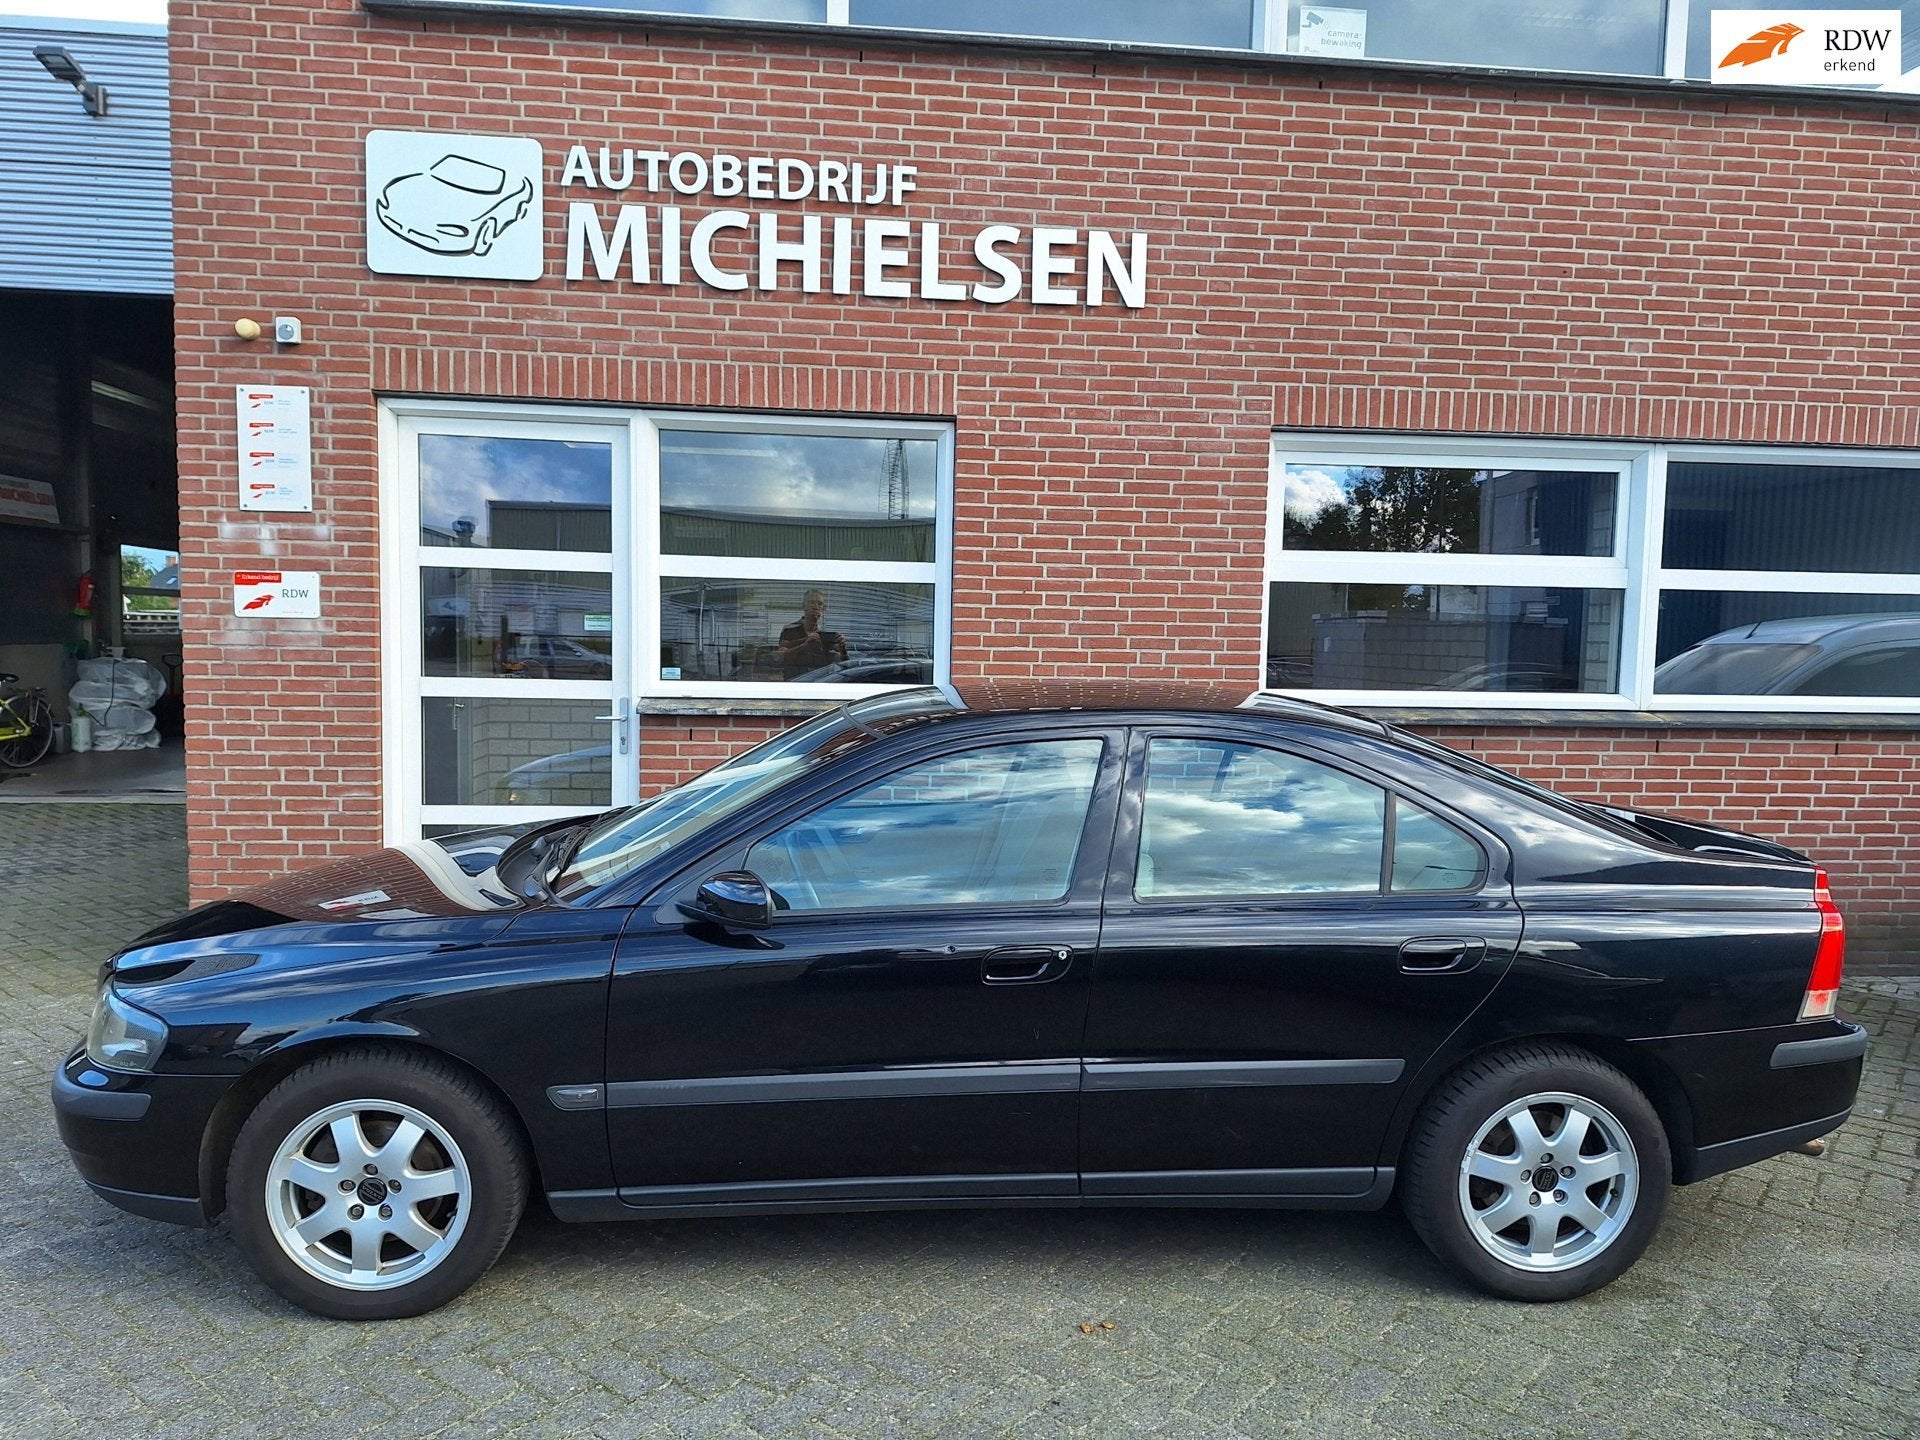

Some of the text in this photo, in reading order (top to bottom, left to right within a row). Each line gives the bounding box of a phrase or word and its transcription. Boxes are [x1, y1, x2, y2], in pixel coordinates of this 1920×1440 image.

[1321, 38, 1362, 50] bewaking
[561, 145, 917, 206] AUTOBEDRIJF
[565, 202, 1148, 309] MICHIELSEN
[281, 588, 309, 599] RDW
